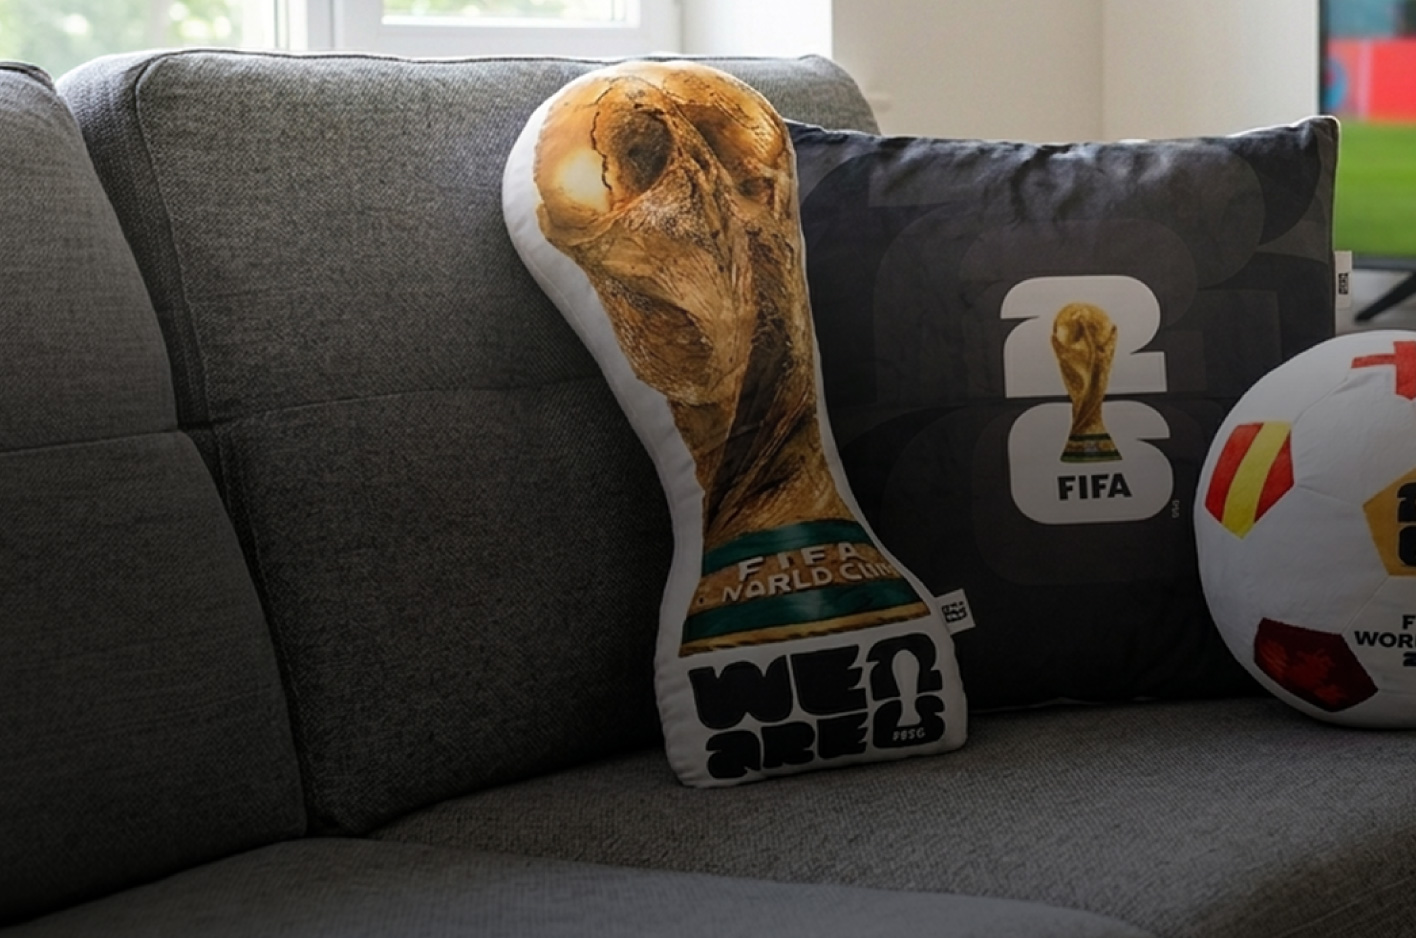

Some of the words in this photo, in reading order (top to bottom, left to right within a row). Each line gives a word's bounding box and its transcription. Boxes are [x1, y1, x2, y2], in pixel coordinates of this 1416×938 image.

[1058, 473, 1132, 500] FIFA
[739, 542, 863, 582] FIFA
[688, 644, 869, 730] WE
